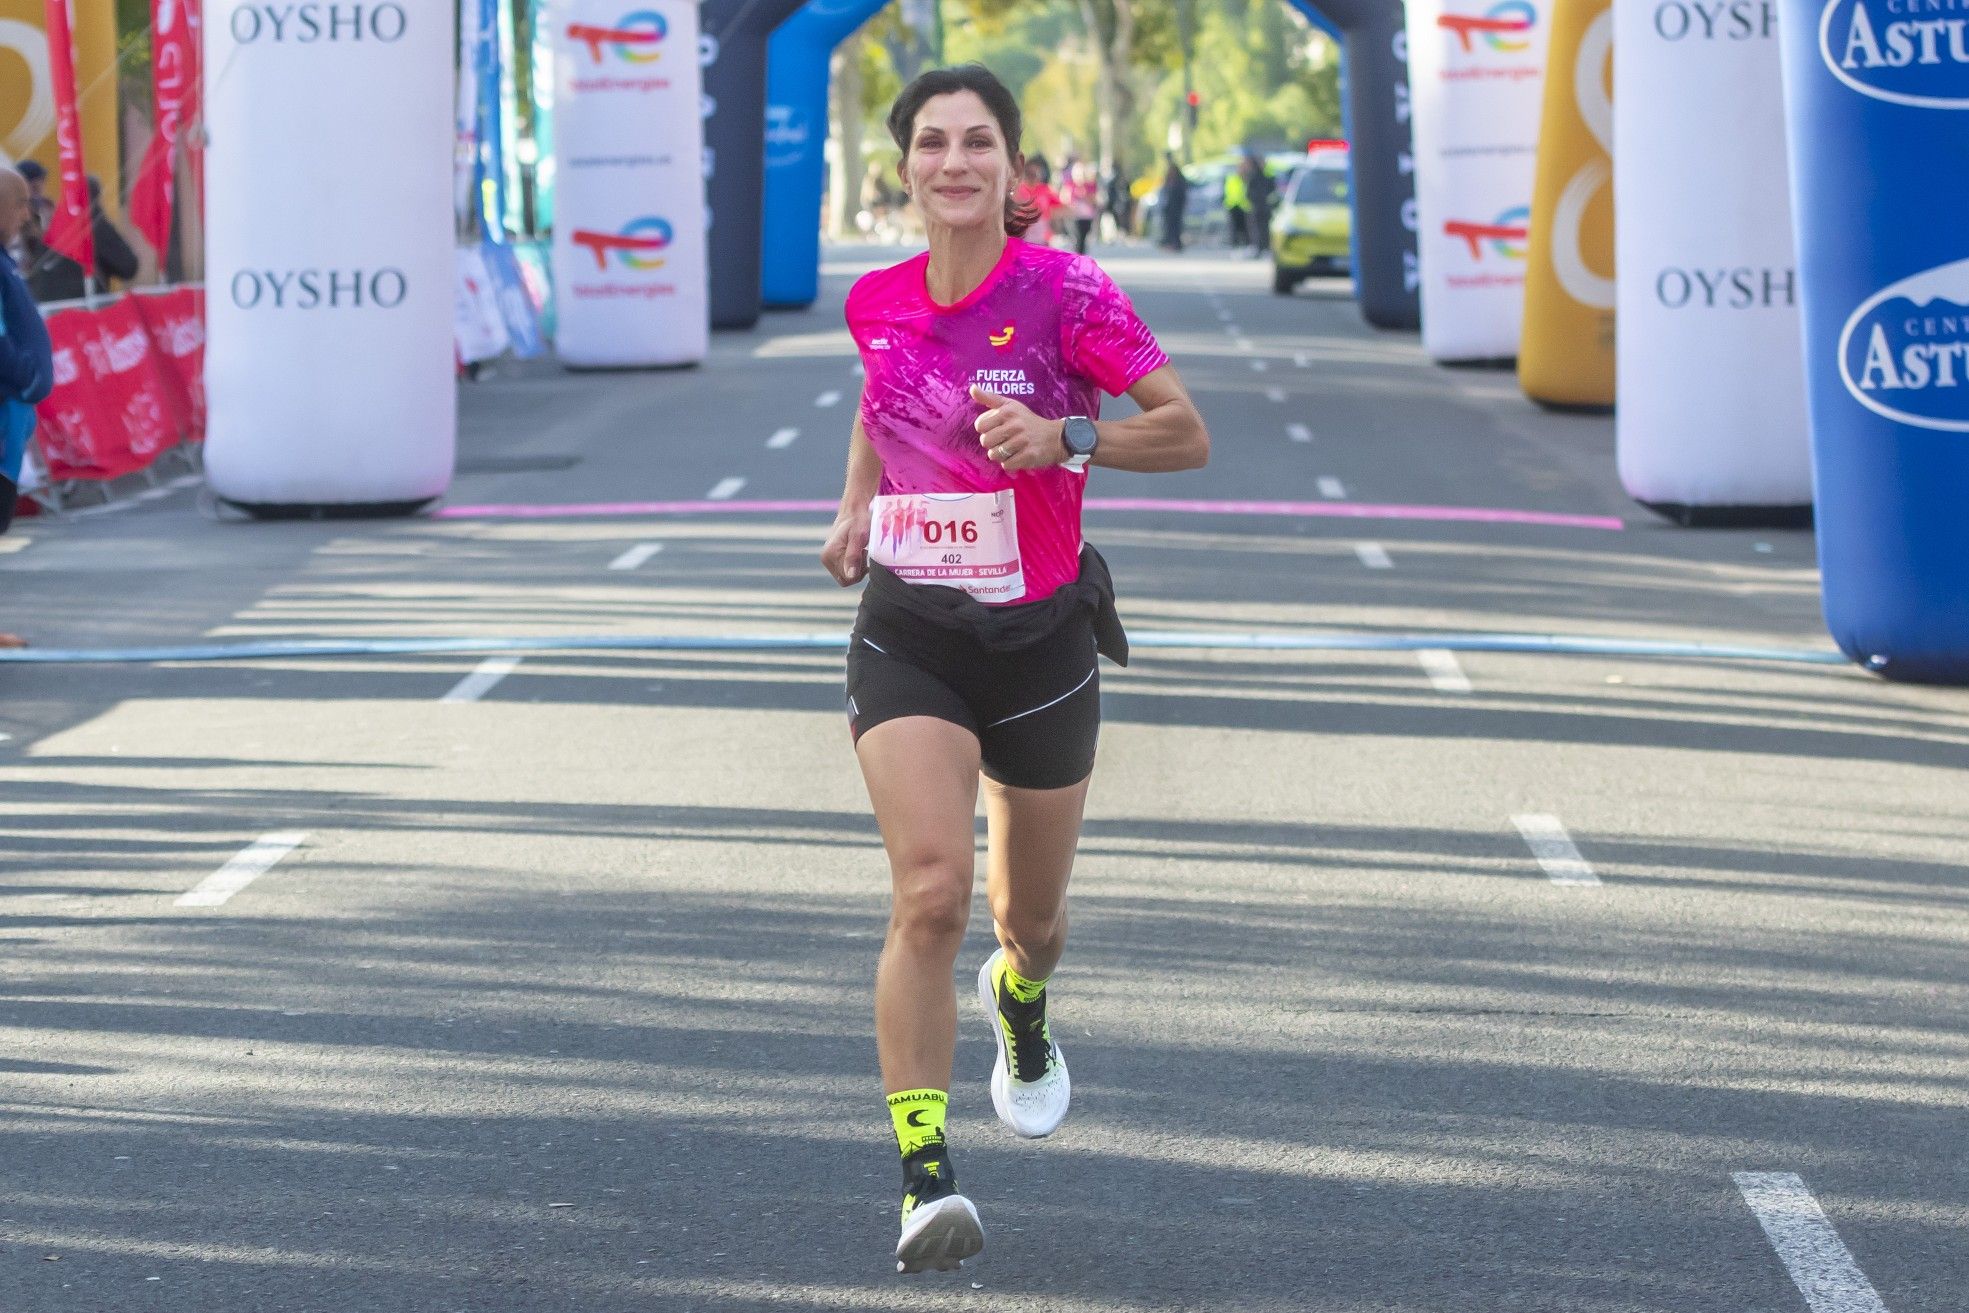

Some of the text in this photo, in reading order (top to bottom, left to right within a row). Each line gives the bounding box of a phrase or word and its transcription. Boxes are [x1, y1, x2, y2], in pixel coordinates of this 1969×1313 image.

[230, 3, 406, 43] OYSHO
[231, 266, 407, 310] OYSHO
[1656, 267, 1794, 309] OYSH
[1860, 321, 1969, 390] AST
[976, 369, 1026, 382] FUERZA
[976, 382, 1035, 395] VALORES
[923, 520, 978, 543] 016
[941, 553, 962, 565] 402
[894, 566, 1007, 577] CARRERA DE LA MUJER SEVILLA
